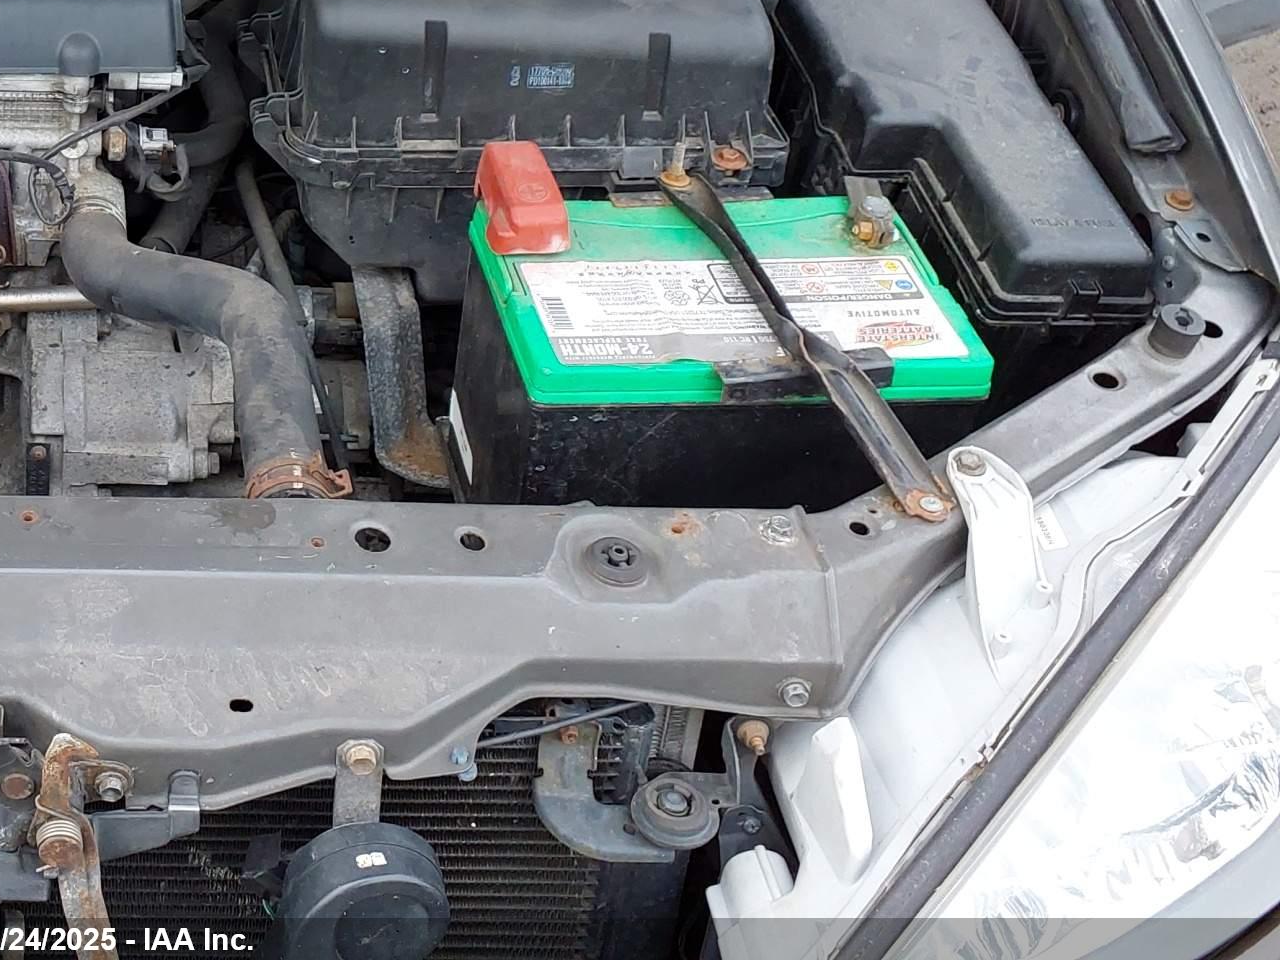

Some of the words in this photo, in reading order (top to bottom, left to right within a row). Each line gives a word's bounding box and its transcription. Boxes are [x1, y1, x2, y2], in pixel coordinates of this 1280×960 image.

[846, 308, 921, 318] AUTOMOTIVE
[857, 325, 933, 336] BATTERIES
[856, 333, 940, 343] INTERSTATE
[559, 343, 654, 357] 24-MONTH
